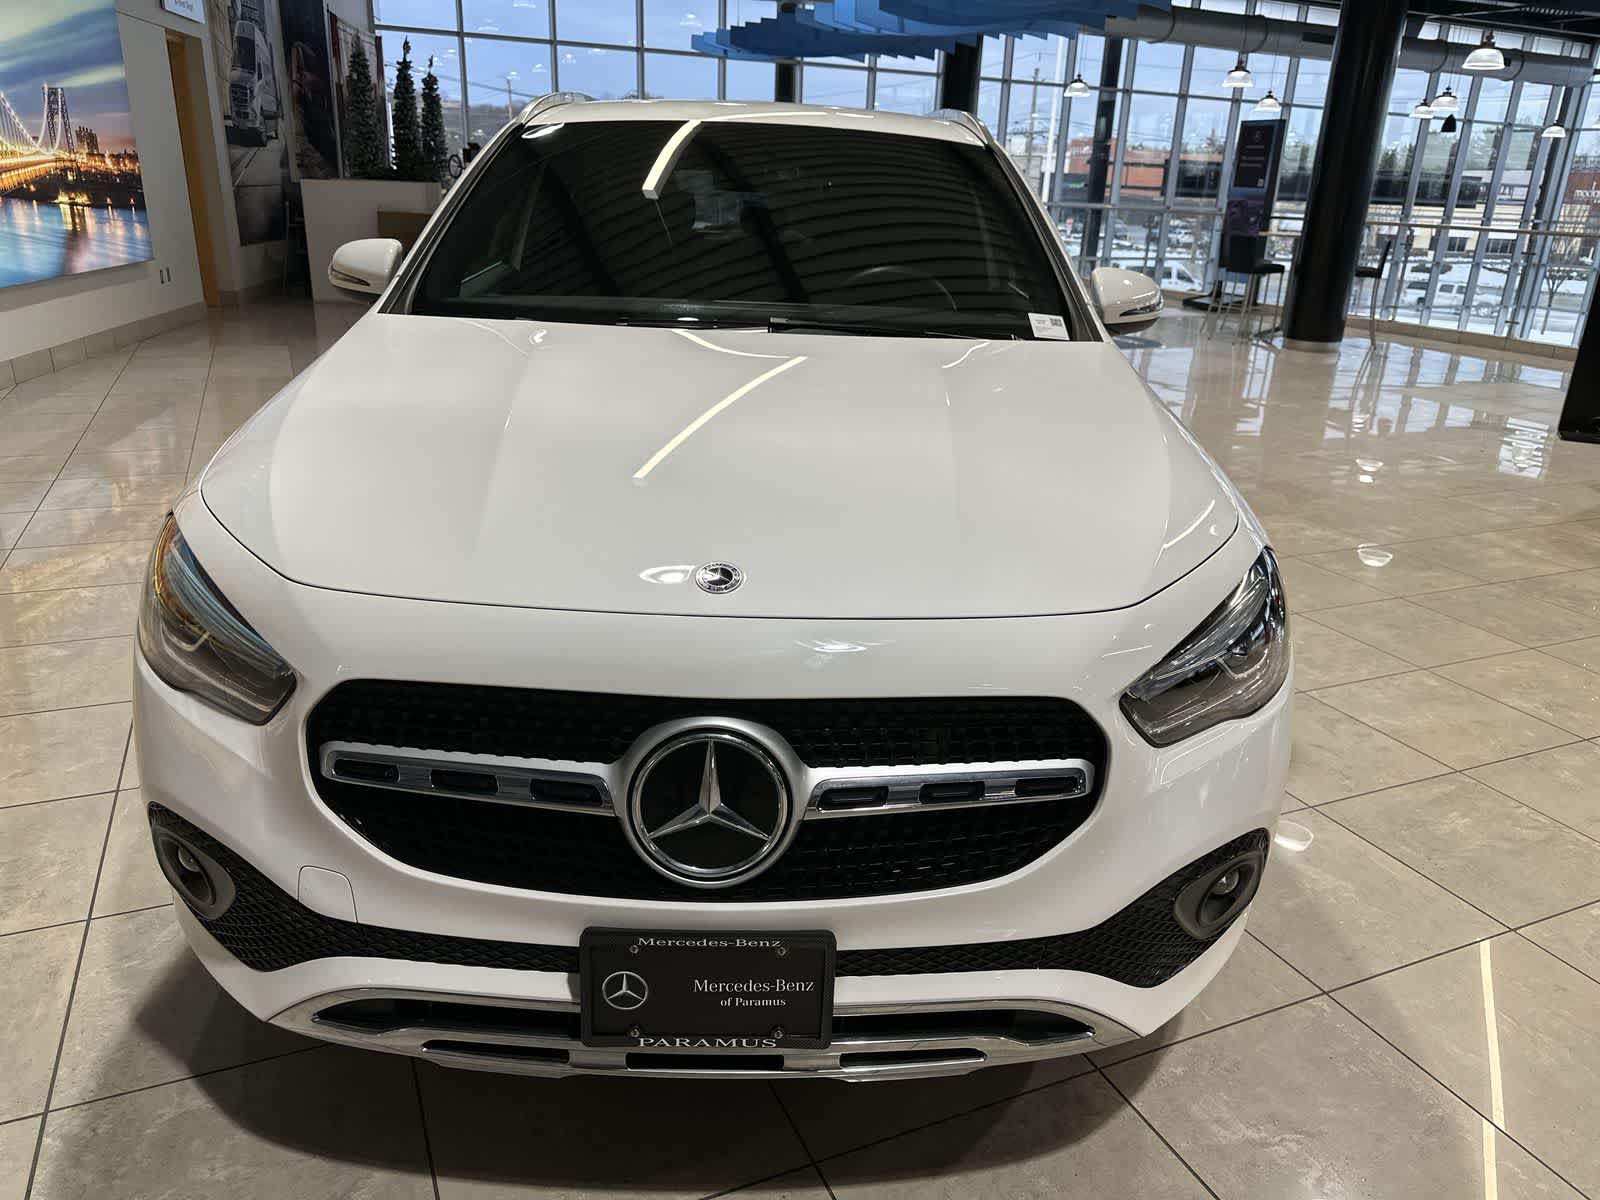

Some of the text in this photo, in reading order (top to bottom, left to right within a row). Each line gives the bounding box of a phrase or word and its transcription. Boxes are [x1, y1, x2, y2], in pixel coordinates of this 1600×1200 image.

[637, 937, 782, 947] Mercedes-Benz
[693, 978, 815, 993] Mercedes-Benz
[720, 997, 787, 1008] of Paramus
[638, 1037, 778, 1048] PARAMUS
